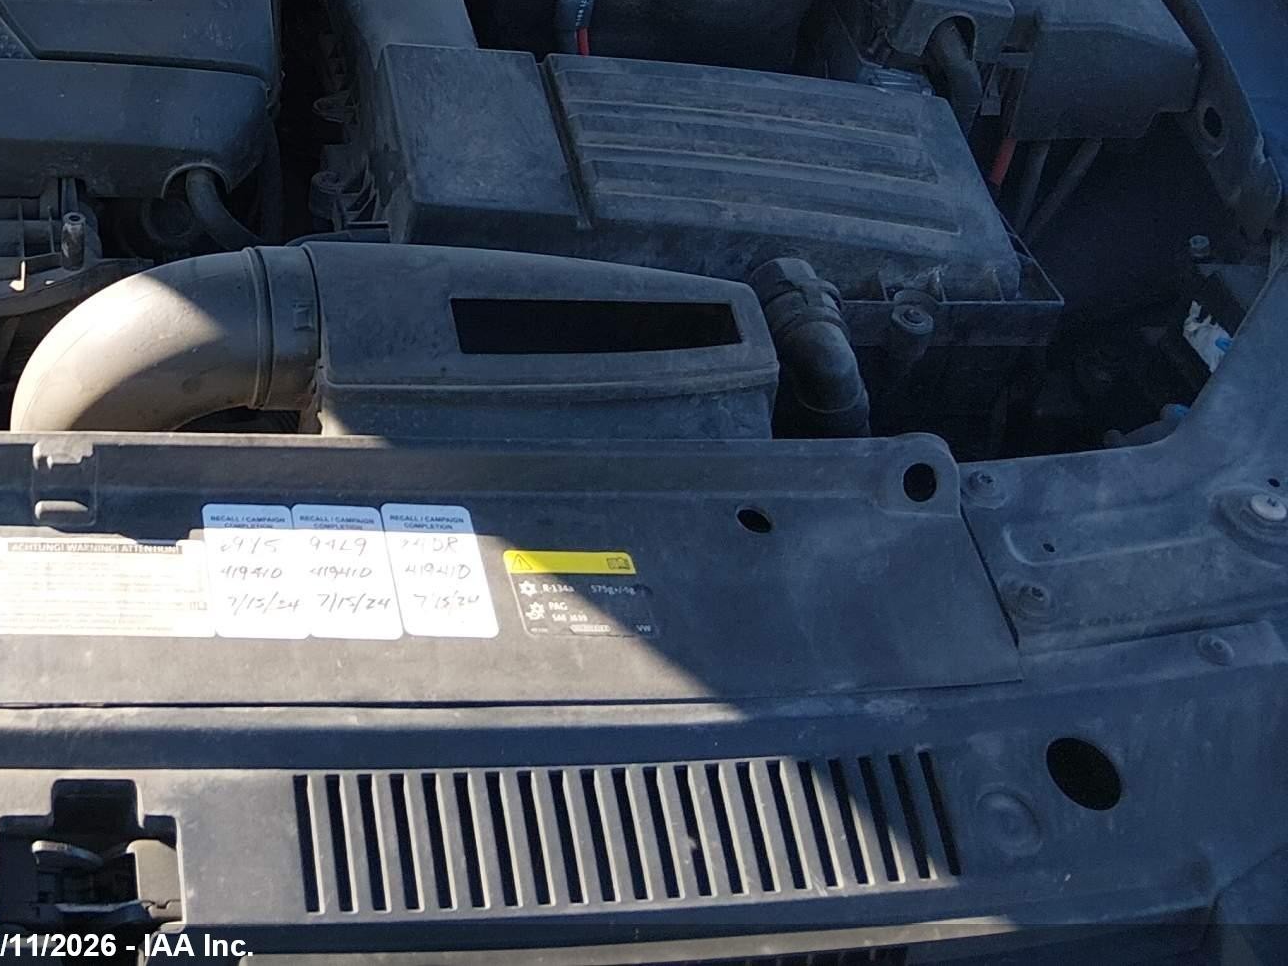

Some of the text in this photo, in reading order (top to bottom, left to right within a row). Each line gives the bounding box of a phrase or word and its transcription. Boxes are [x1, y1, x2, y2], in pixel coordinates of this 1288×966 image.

[404, 522, 453, 530] COMPLETION
[11, 542, 63, 552] ACHTUNG!
[66, 543, 118, 553] WARNING!
[317, 592, 391, 614] 7/15/24
[548, 601, 568, 611] PAG
